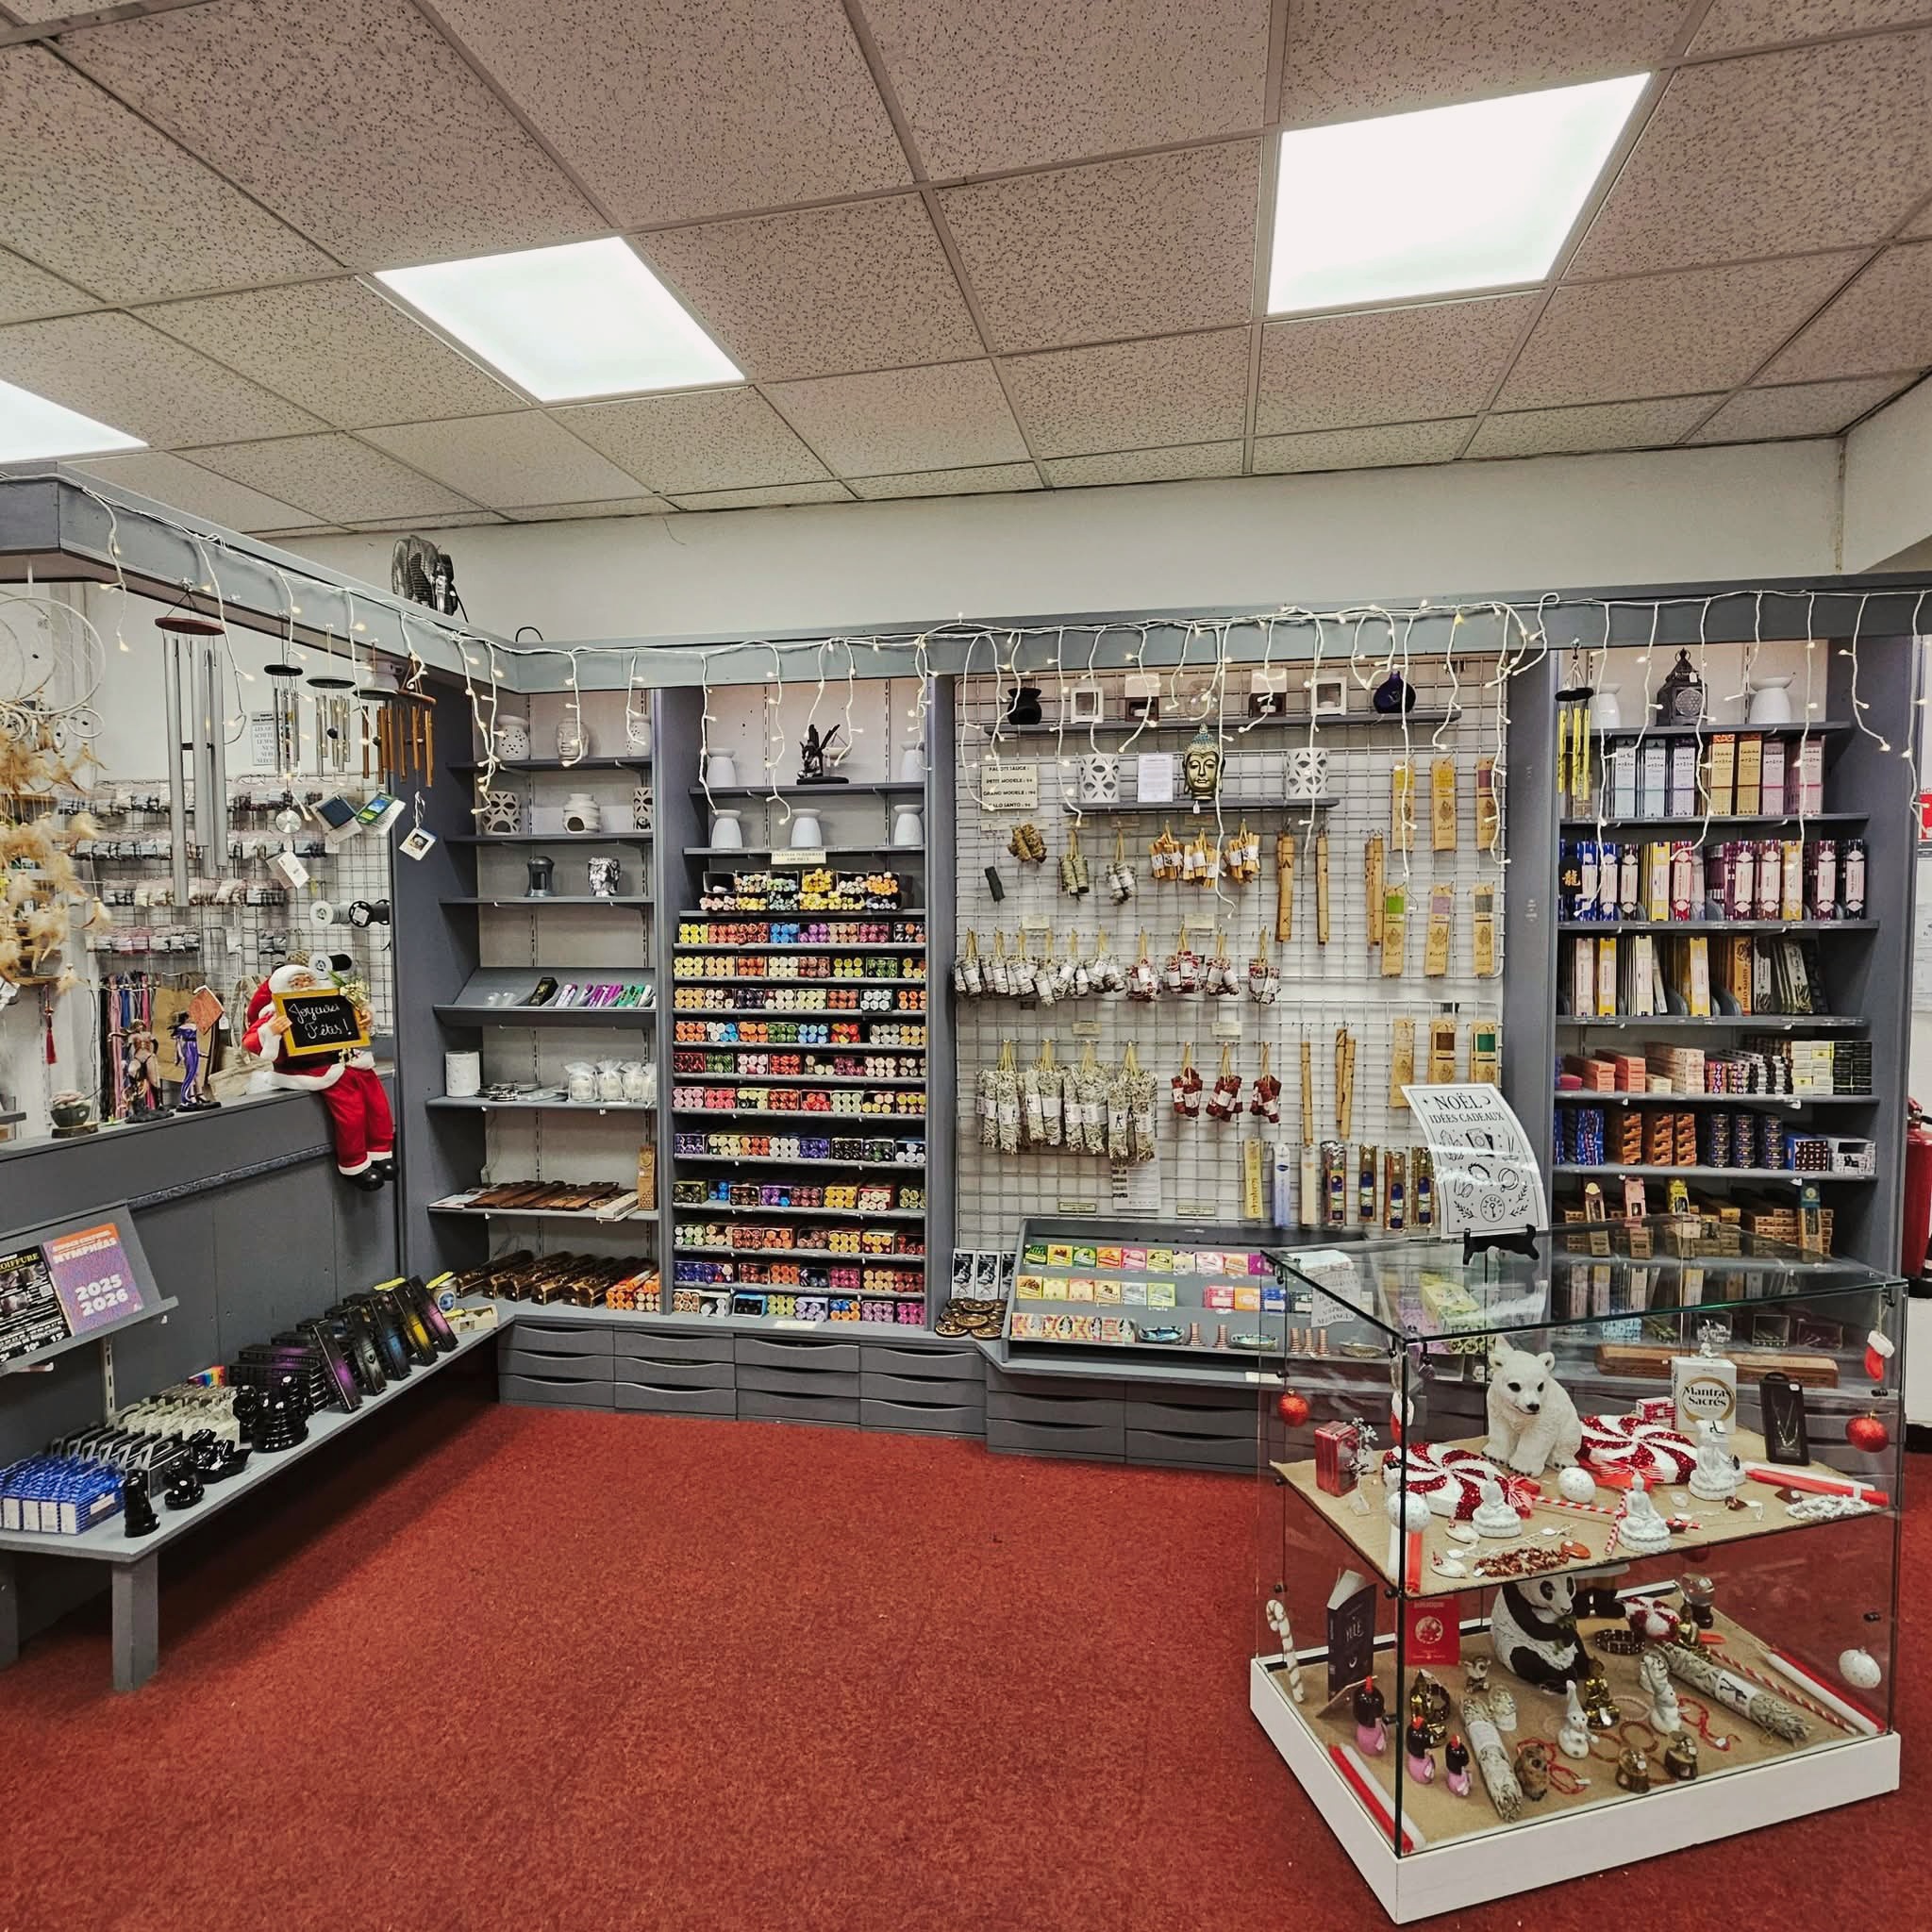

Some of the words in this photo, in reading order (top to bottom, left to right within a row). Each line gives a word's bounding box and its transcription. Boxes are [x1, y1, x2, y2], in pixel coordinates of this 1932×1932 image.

[1562, 869, 1581, 887] 龍
[288, 1003, 340, 1024] Joyeuses
[304, 1021, 342, 1040] Fêtes
[1433, 1092, 1483, 1110] NOËL
[1428, 1111, 1458, 1124] IDÉES
[1460, 1111, 1505, 1123] CADEAUX
[0, 1252, 40, 1272] OIFFURE
[75, 1274, 123, 1302] 2025
[80, 1288, 128, 1317] 2026
[1688, 1396, 1727, 1407] Sacrés
